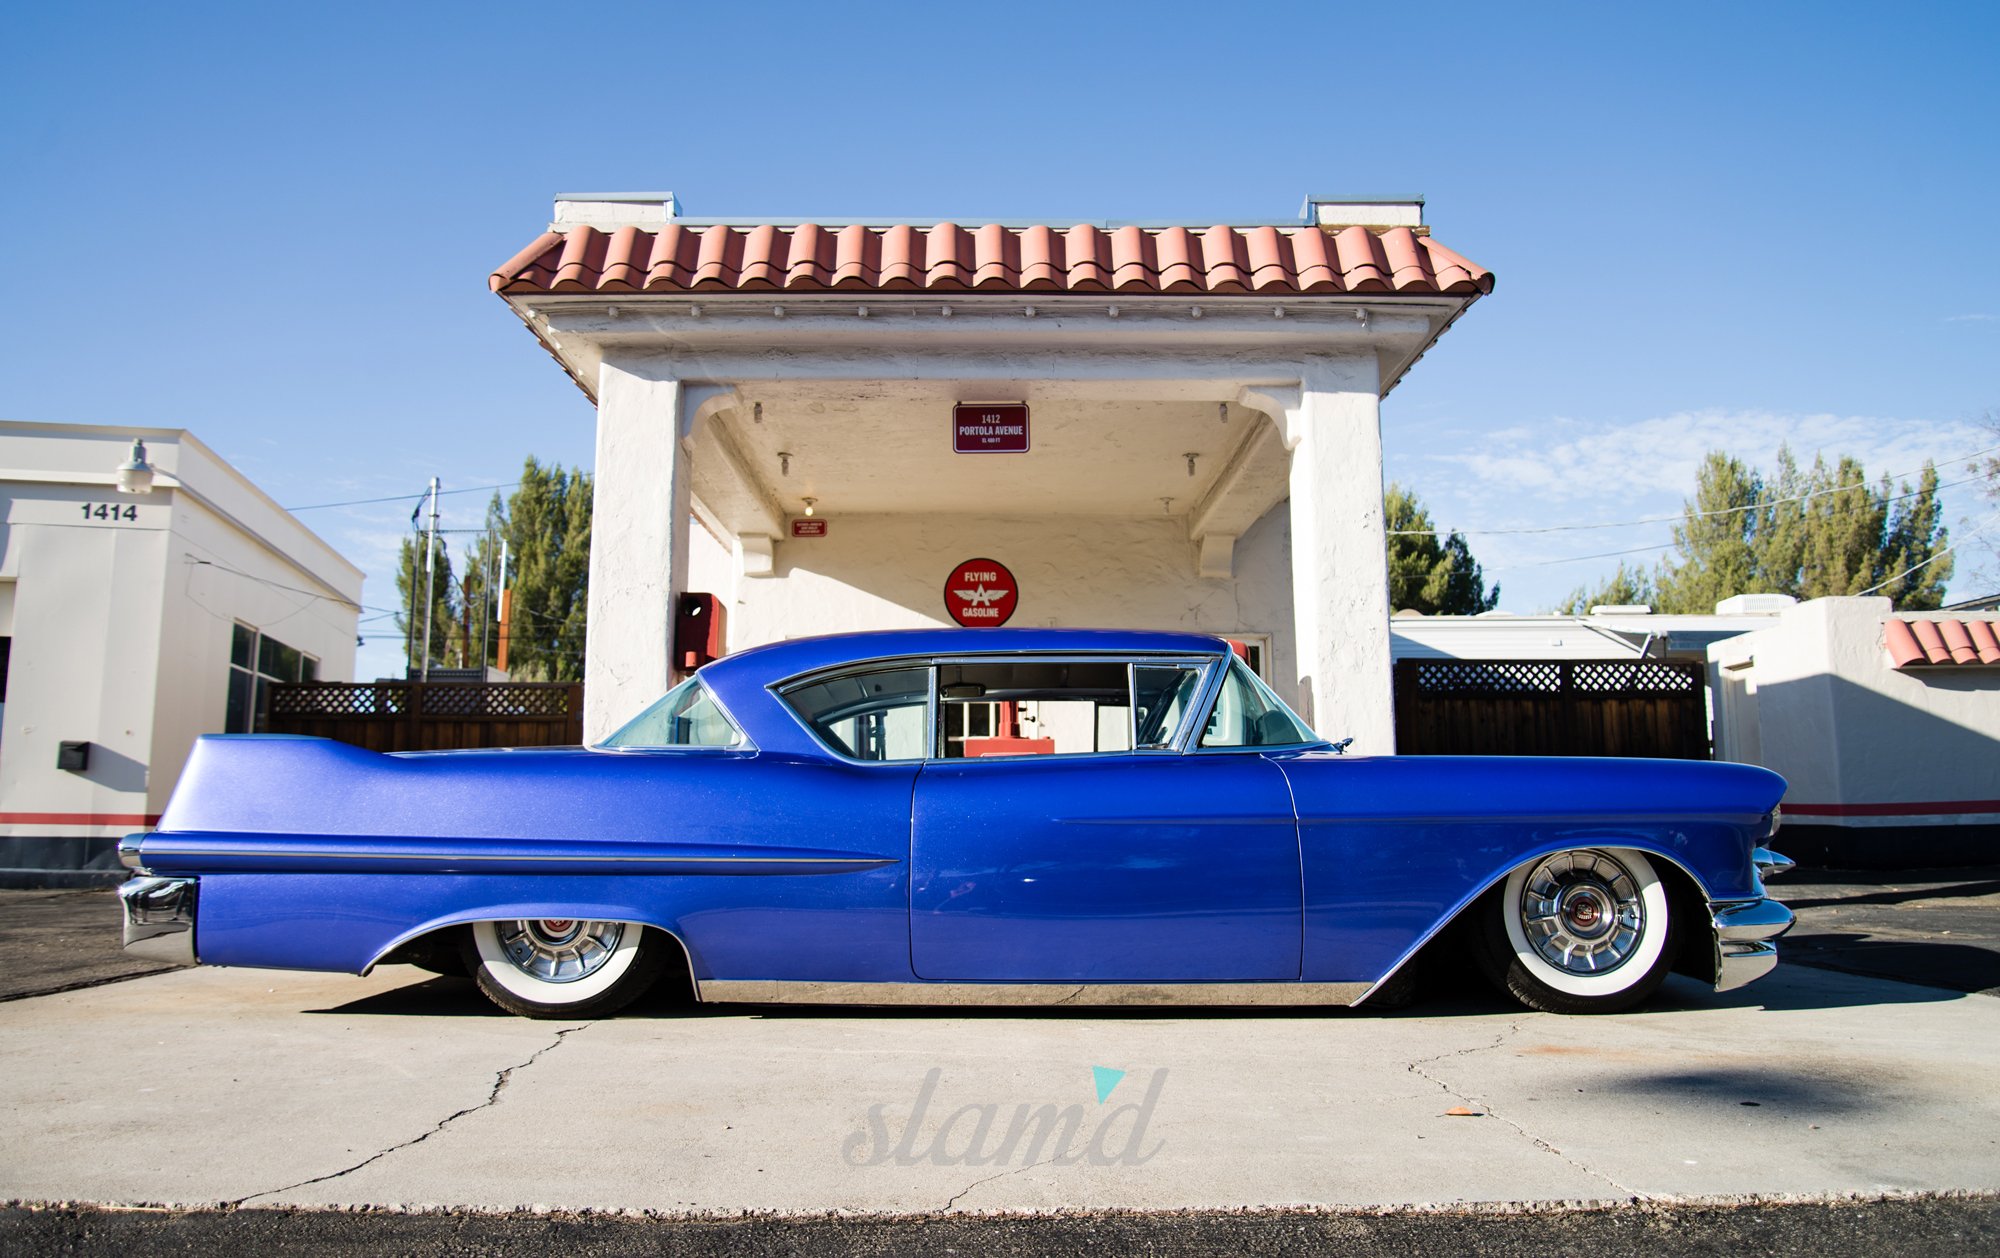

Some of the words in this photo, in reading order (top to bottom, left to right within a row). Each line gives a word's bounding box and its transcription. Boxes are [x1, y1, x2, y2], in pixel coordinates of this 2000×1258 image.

[981, 414, 1001, 424] 1412
[959, 425, 994, 436] PORTOLA
[994, 425, 1024, 436] AVENUE
[81, 502, 138, 522] 1414
[964, 571, 997, 582] FLYING
[962, 607, 999, 618] GASOLINE
